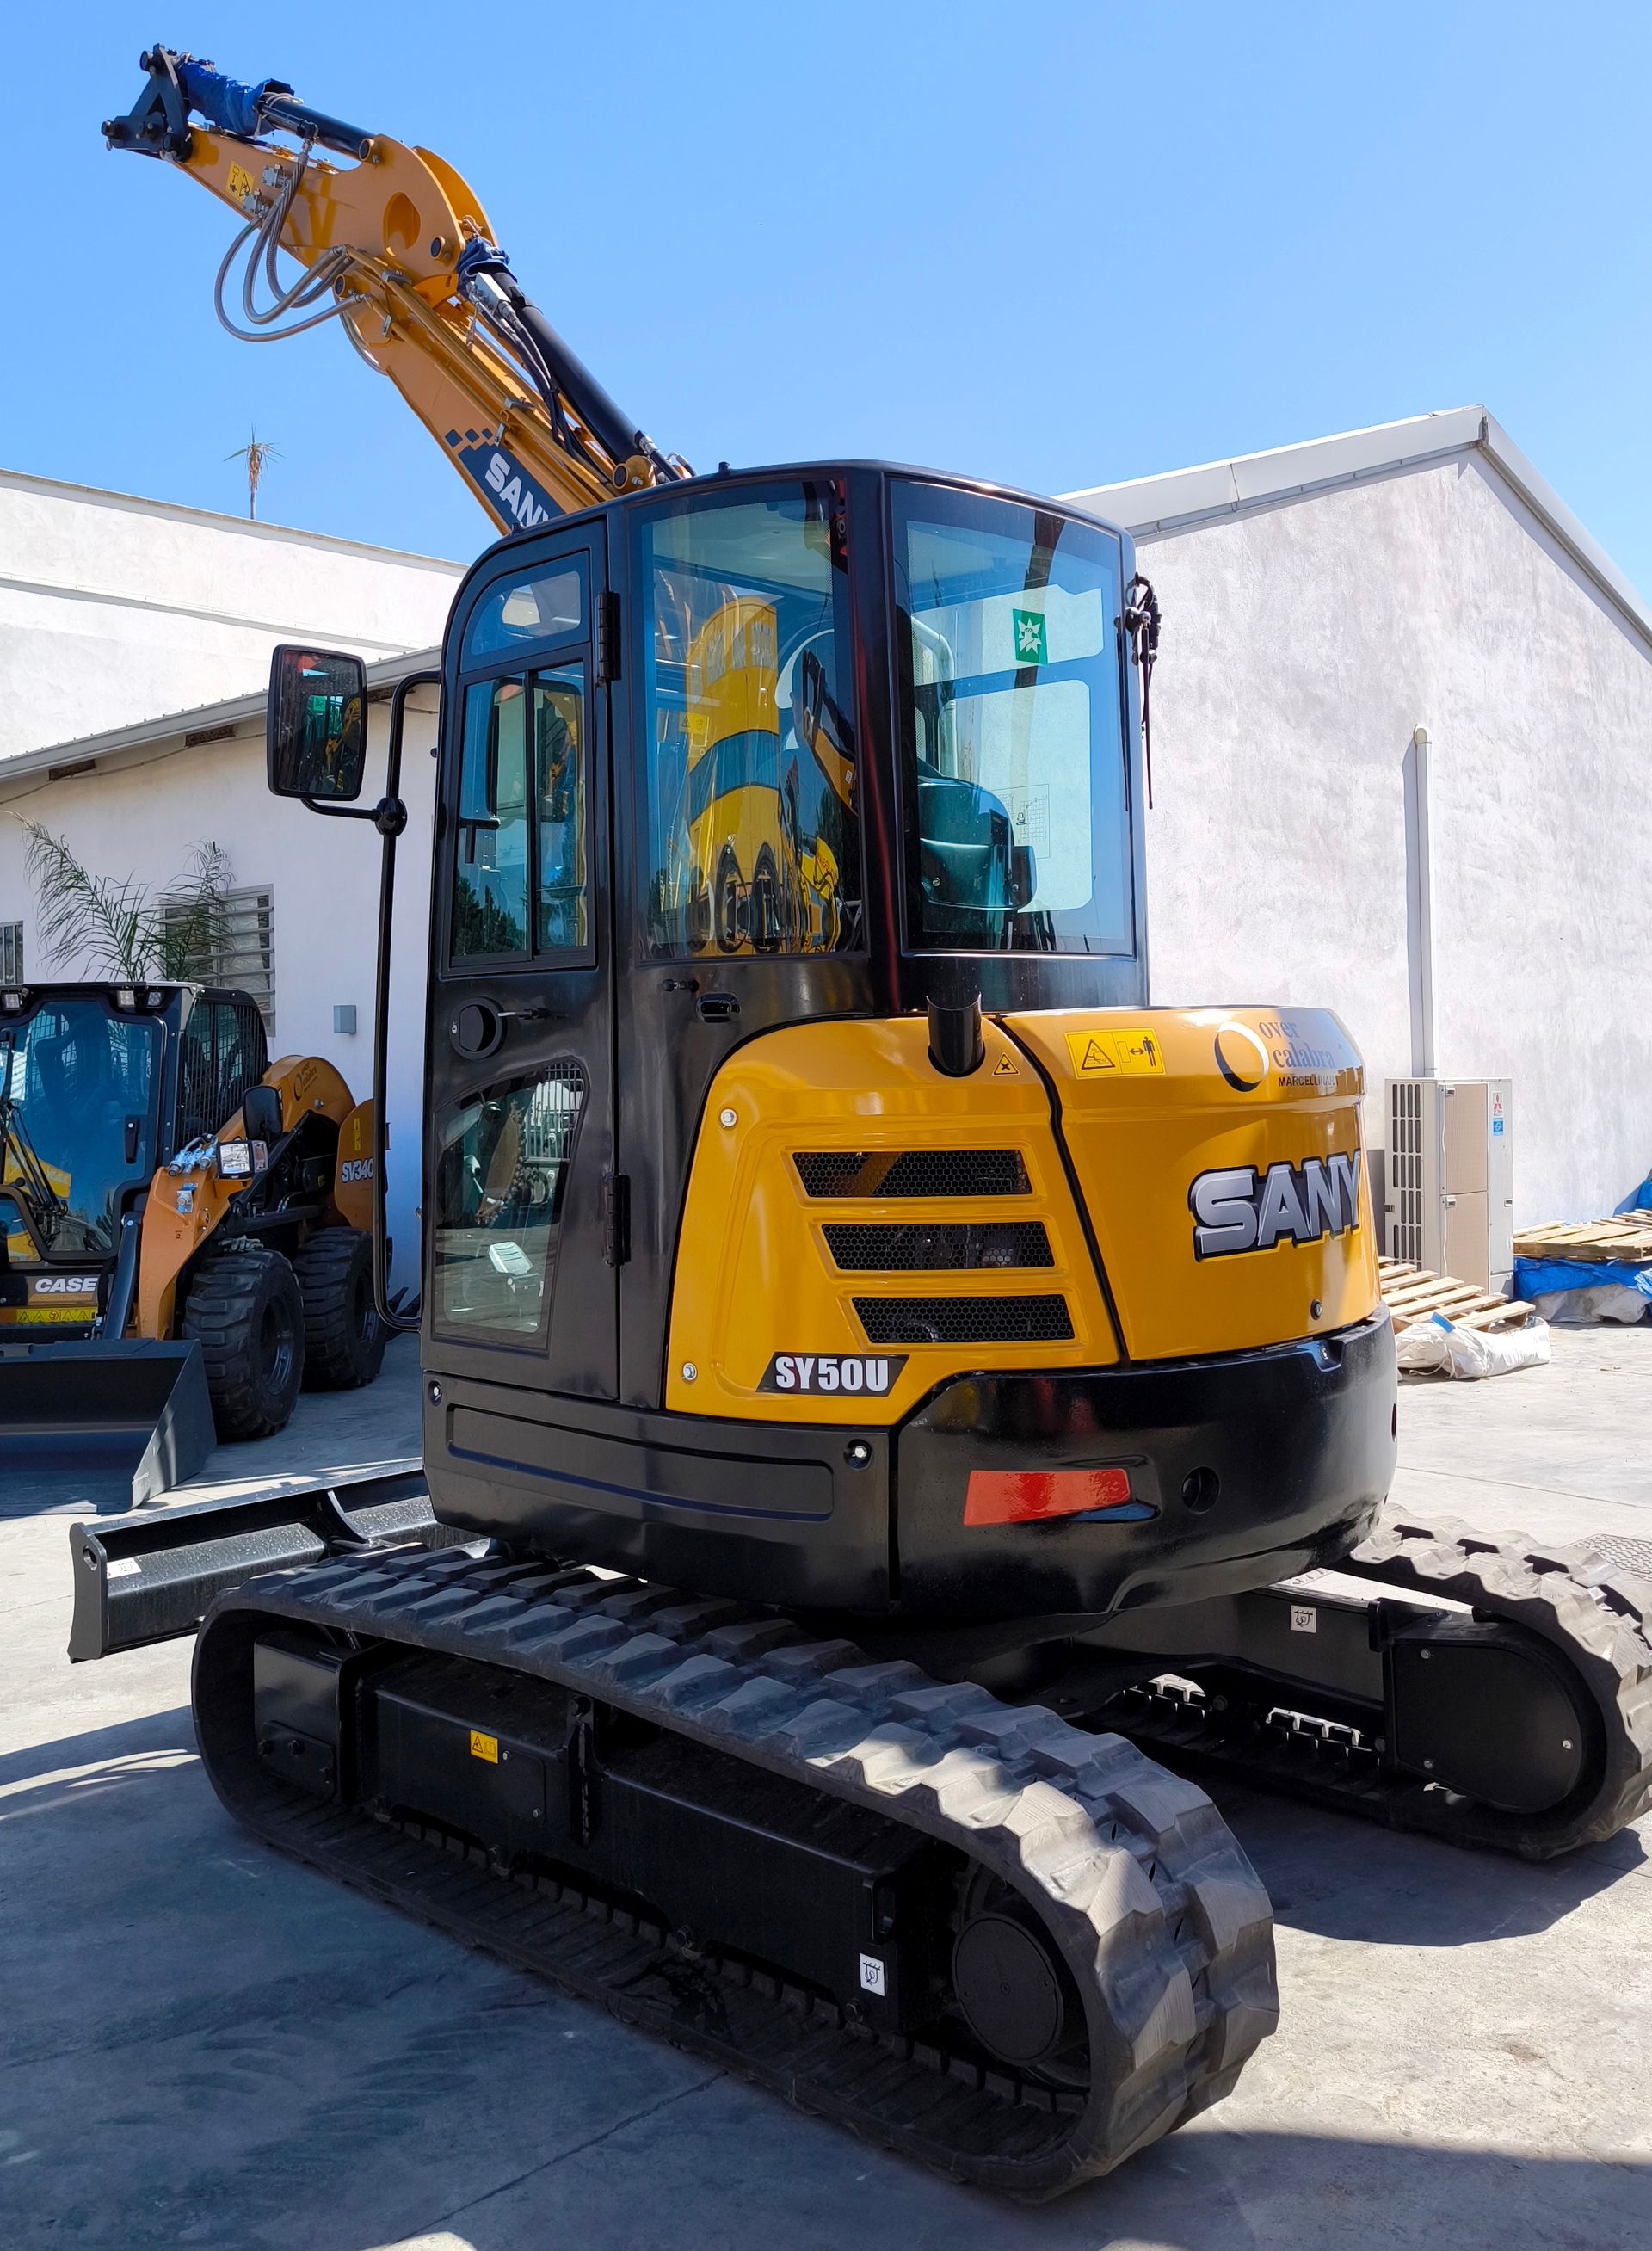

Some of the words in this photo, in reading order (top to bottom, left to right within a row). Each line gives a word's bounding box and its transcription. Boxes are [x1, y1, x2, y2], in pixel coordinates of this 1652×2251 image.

[484, 453, 549, 527] SAN
[1259, 1021, 1301, 1039] over
[1273, 1042, 1336, 1070] calabra
[1187, 1148, 1362, 1256] SANY
[34, 1277, 99, 1292] CASE
[775, 1356, 890, 1392] SY50U
